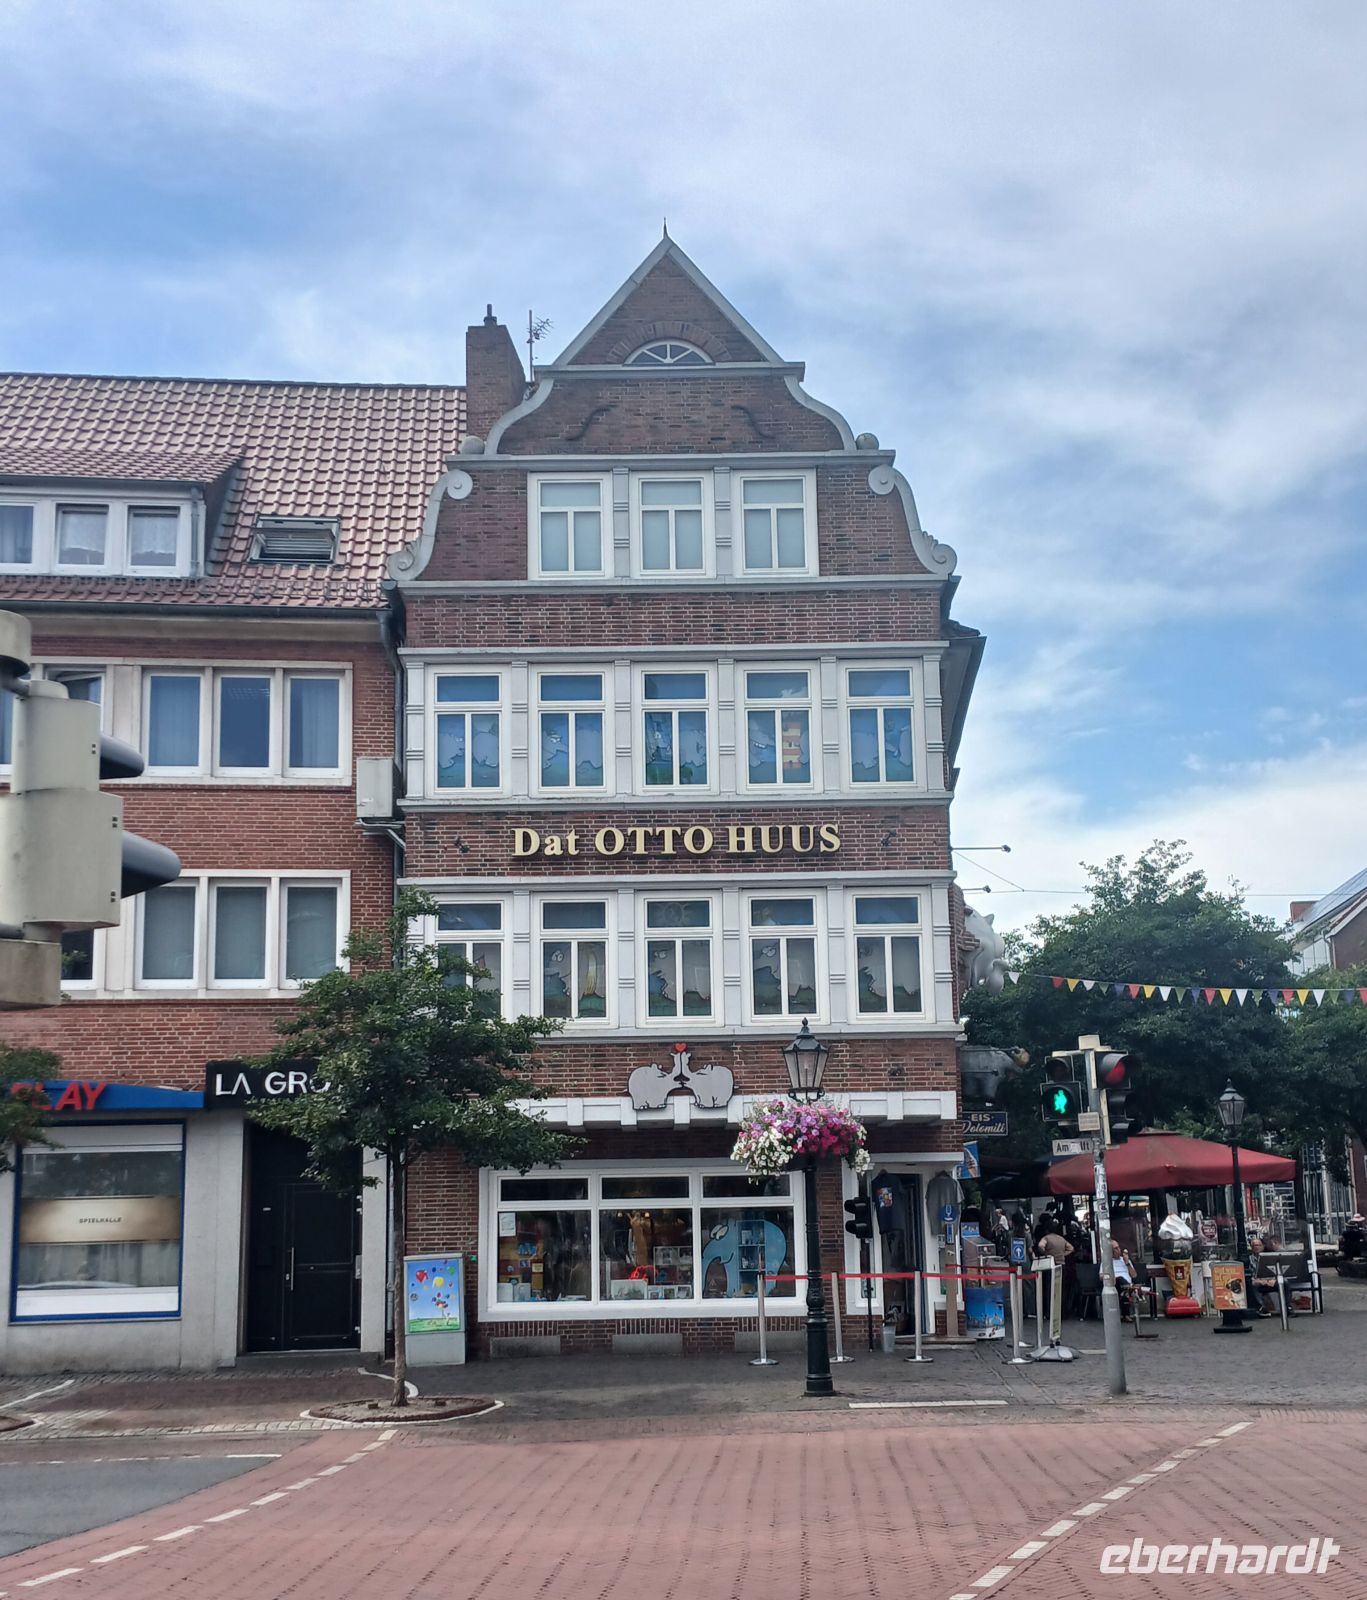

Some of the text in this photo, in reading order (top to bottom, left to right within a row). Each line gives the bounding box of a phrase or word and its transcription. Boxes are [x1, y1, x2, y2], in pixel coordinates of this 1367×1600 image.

[510, 823, 842, 857] Dat OTTO HUUS
[215, 1071, 343, 1096] LA GRO
[970, 1113, 991, 1122] EIS
[1056, 1140, 1090, 1153] Am lft
